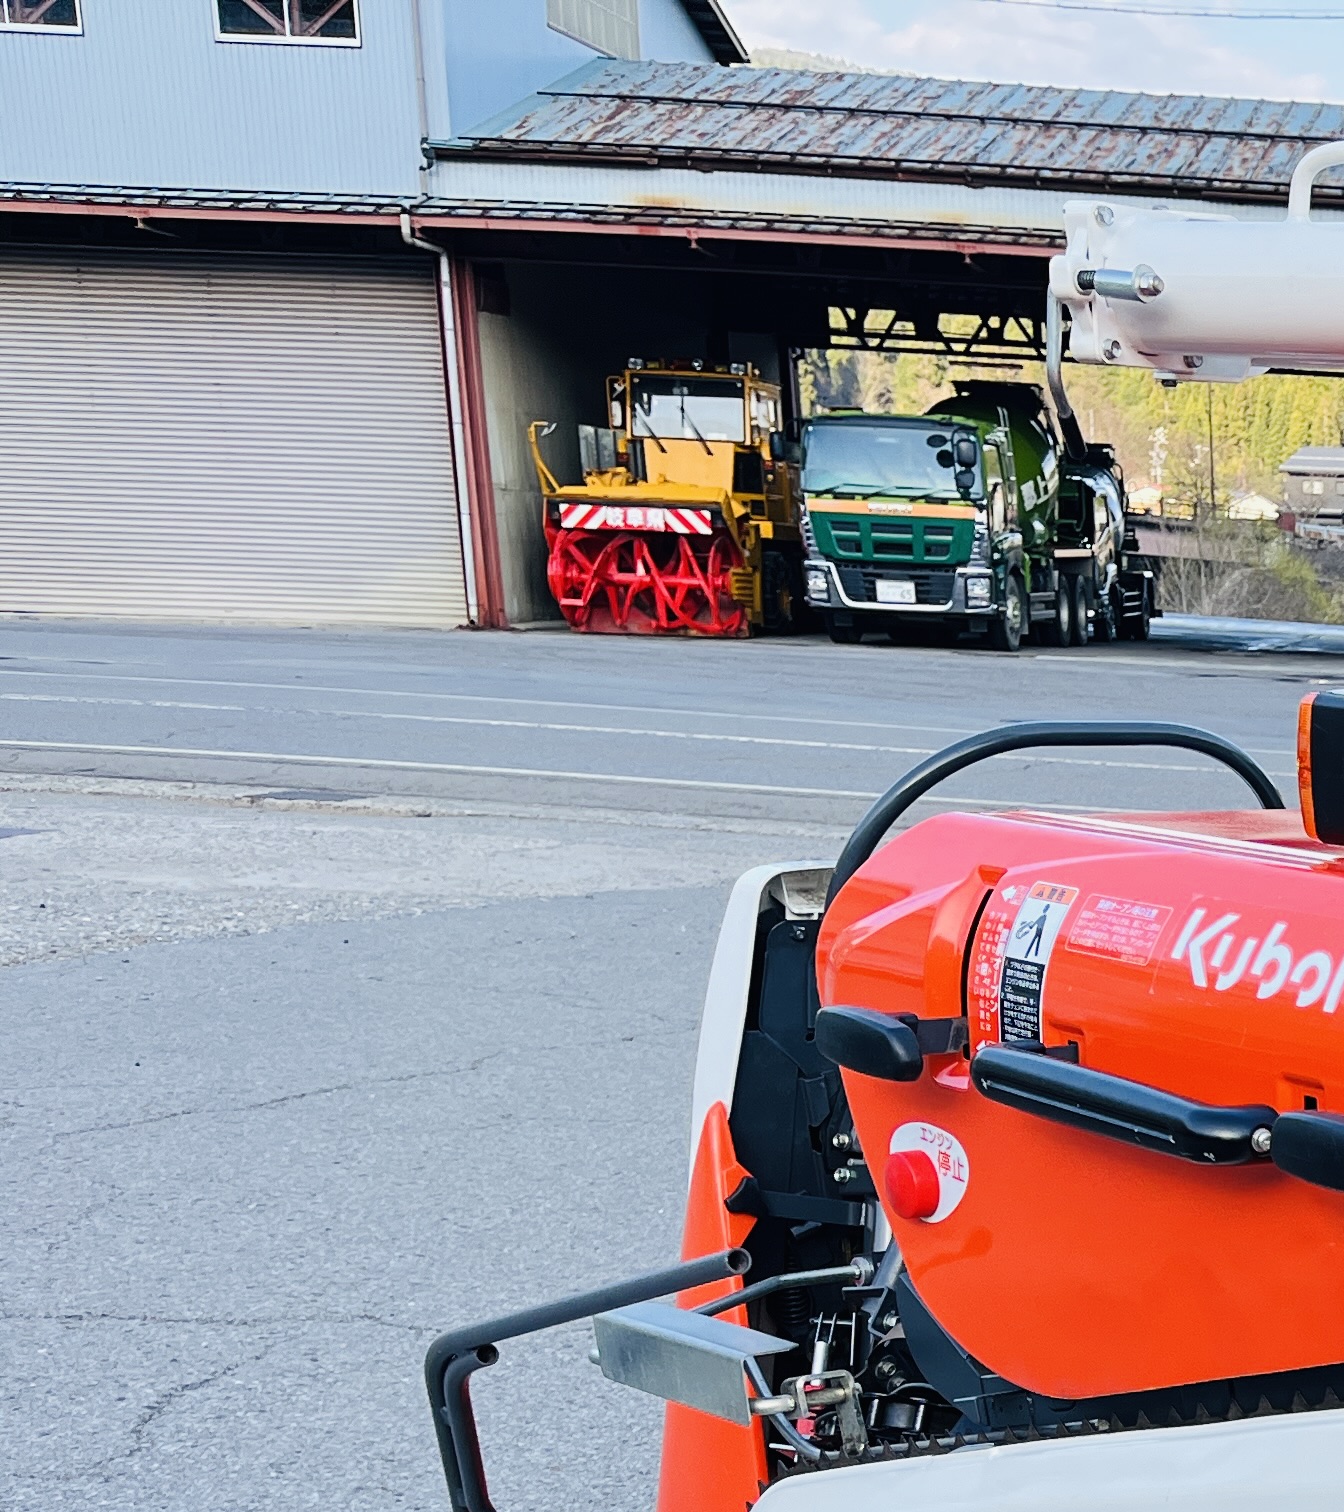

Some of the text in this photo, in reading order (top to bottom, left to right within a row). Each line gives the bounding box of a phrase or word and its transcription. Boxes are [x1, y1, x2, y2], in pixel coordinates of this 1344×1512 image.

[920, 1126, 953, 1150] エンジン
[938, 1150, 965, 1183] 停止
